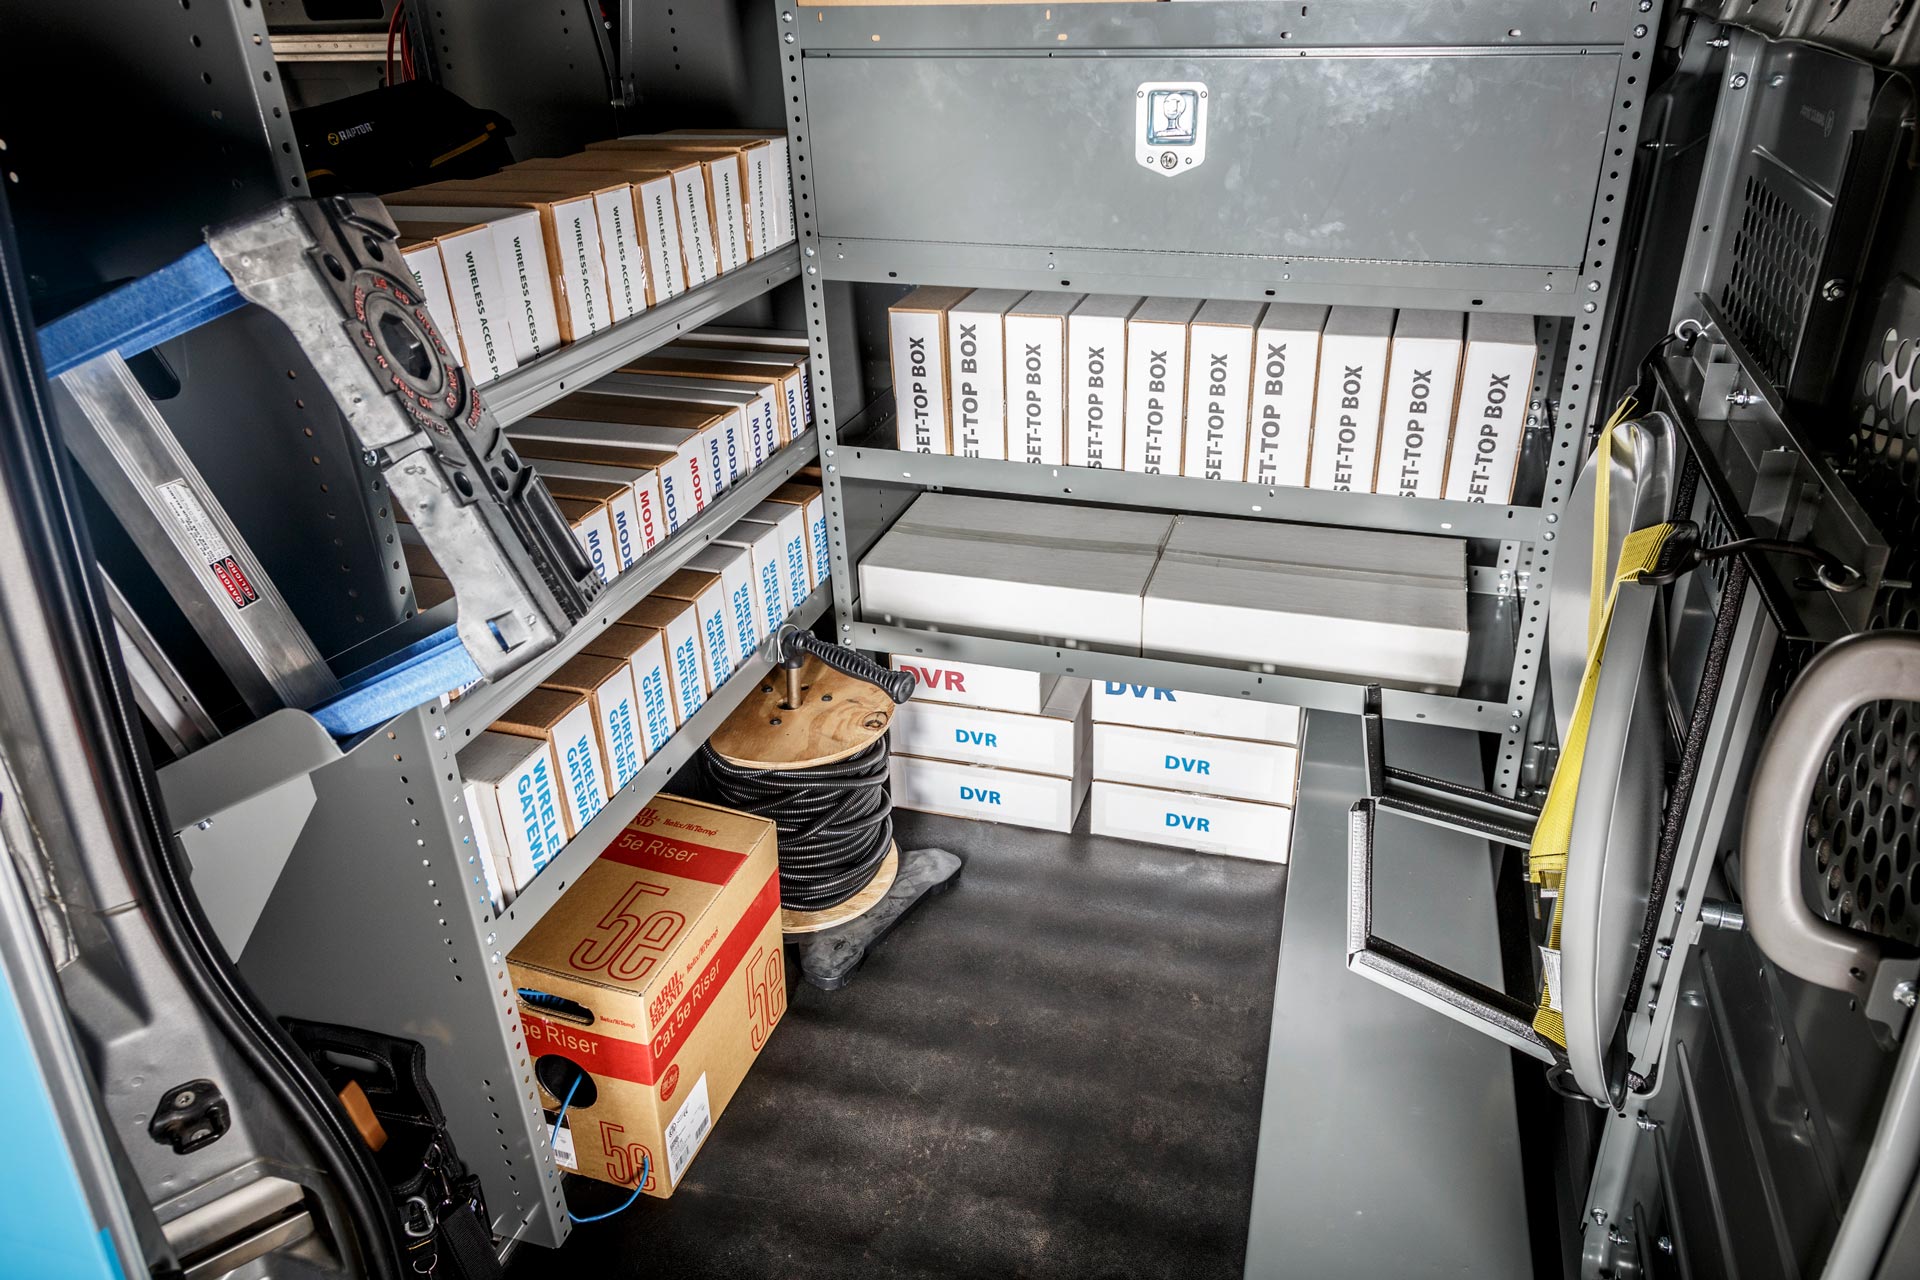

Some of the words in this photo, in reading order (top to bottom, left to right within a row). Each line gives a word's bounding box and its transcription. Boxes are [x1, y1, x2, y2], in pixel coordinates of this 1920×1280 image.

[338, 122, 373, 141] RAPTOR
[686, 183, 699, 234] WIRELESS
[694, 236, 705, 273] ACCESS
[724, 172, 733, 222] WIRELESS
[729, 223, 738, 259] ACCESS
[612, 206, 626, 262] WIRELESS
[621, 264, 633, 305] ACCESS
[655, 194, 667, 248] WIRELESS
[662, 250, 672, 289] ACCESS
[513, 236, 530, 297] WIRELESS
[524, 299, 539, 344] ACCESS
[574, 217, 588, 276] WIRELESS
[582, 278, 595, 321] ACCESS
[465, 250, 486, 315] WIRELESS
[480, 317, 497, 369] ACCESS
[909, 336, 927, 378] BOX
[960, 323, 978, 374] BOX
[1025, 343, 1042, 386] BOX
[1088, 346, 1105, 389] BOX
[1149, 350, 1168, 394] BOX
[1264, 343, 1287, 396] BOX
[803, 374, 812, 423] MODE
[1209, 353, 1228, 397] BOX
[1341, 365, 1363, 410] BOX
[1409, 368, 1432, 414] BOX
[1483, 373, 1511, 419] BOX
[752, 418, 763, 468] MODE
[764, 402, 775, 453] MODE
[711, 438, 723, 493] MODE
[726, 428, 738, 480] MODE
[664, 476, 679, 535] MODE
[690, 457, 705, 513] MODE
[616, 510, 634, 572] MODE
[640, 490, 656, 549] MODE
[215, 566, 242, 604] DANGER
[228, 561, 253, 597] PELIGRO
[794, 535, 807, 604] WIRELESS
[741, 582, 757, 656] WIRELESS
[762, 566, 777, 635] GATEWAY
[899, 664, 967, 693] DVR
[1104, 680, 1177, 703] DVR
[955, 729, 998, 748] DVR
[1164, 754, 1210, 775] DVR
[533, 757, 561, 861] WIRELE
[959, 785, 1001, 805] DVR
[618, 833, 644, 851] 5e
[645, 839, 698, 862] Riser
[1165, 812, 1210, 833] DVR
[569, 881, 686, 982] 5e
[649, 970, 683, 1018] CAROL
[651, 980, 685, 1031] BRAND
[653, 1021, 676, 1059] Cat
[676, 1002, 691, 1028] 5e
[691, 958, 721, 1007] Riser
[746, 946, 785, 1052] 5e
[545, 1025, 599, 1055] Riser
[599, 1120, 656, 1192] 5e
